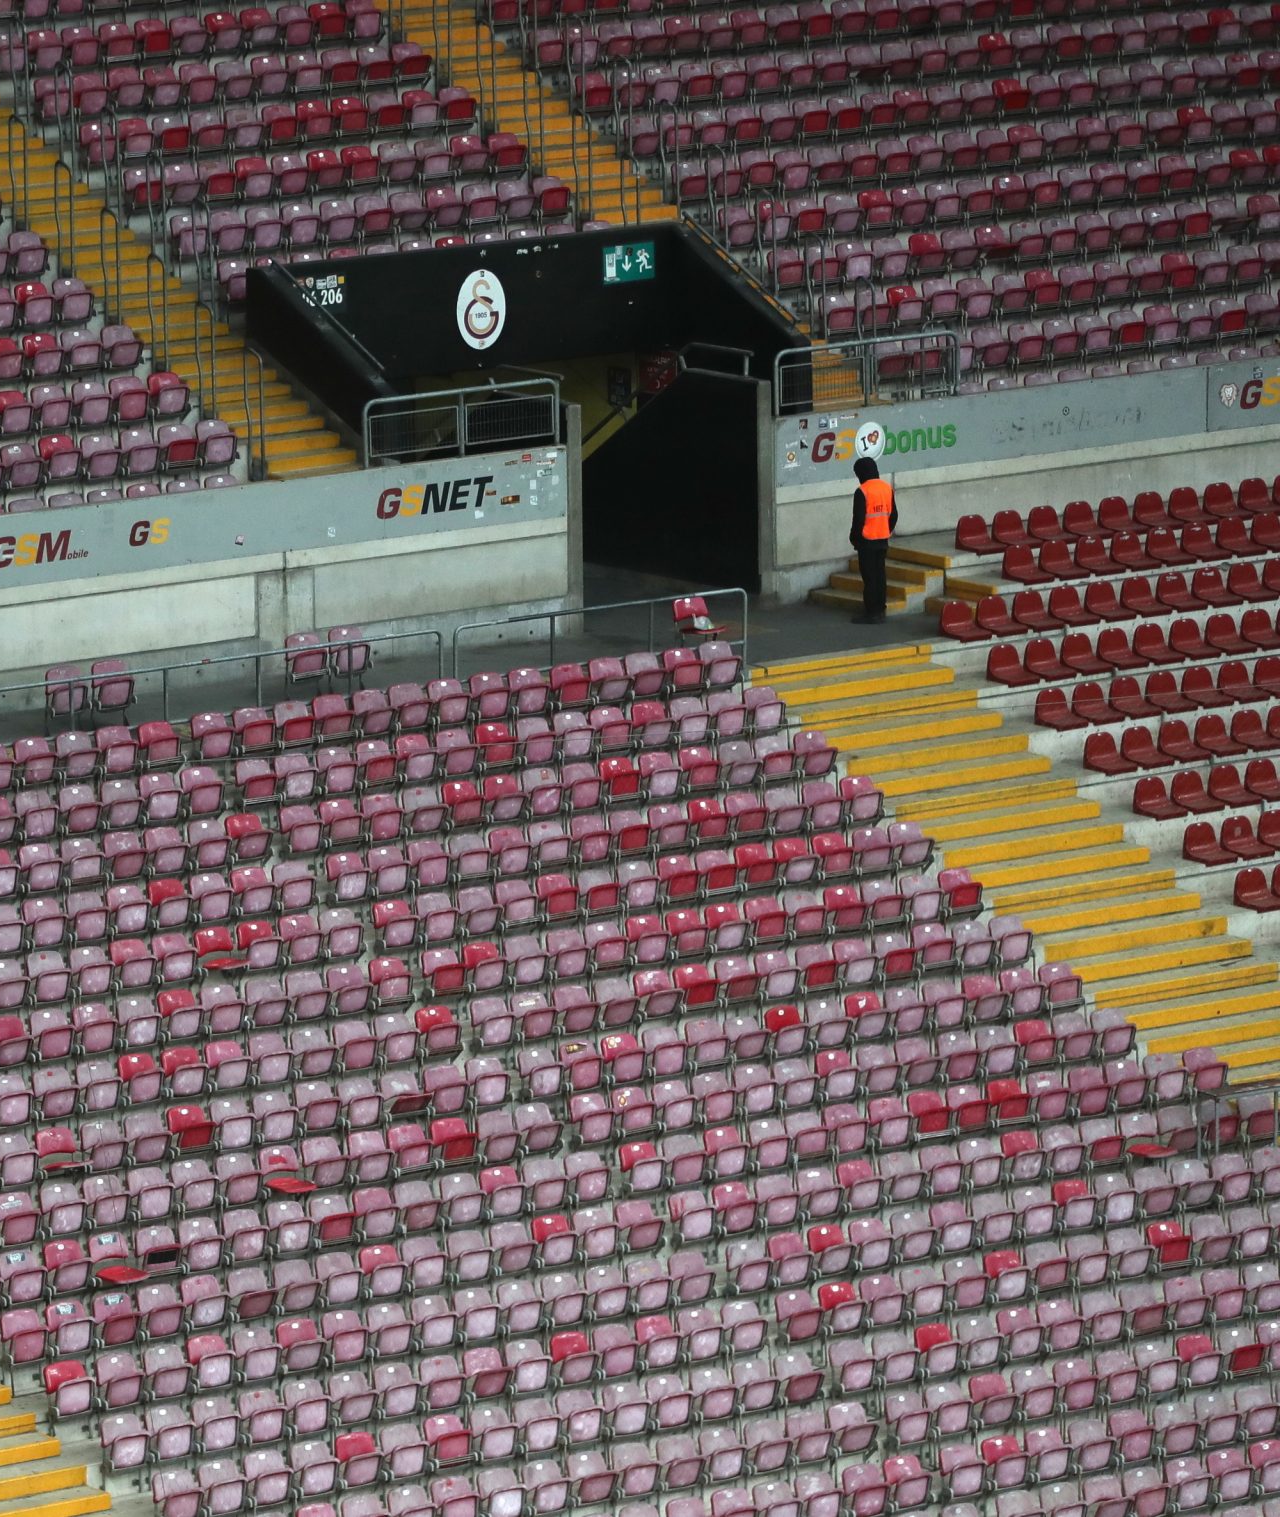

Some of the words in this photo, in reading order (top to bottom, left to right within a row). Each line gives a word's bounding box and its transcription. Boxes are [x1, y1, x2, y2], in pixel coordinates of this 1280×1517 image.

[320, 288, 343, 306] 206
[811, 428, 858, 464] GS
[882, 423, 957, 457] bonus
[376, 475, 494, 520] GSNET
[128, 517, 171, 547] GS
